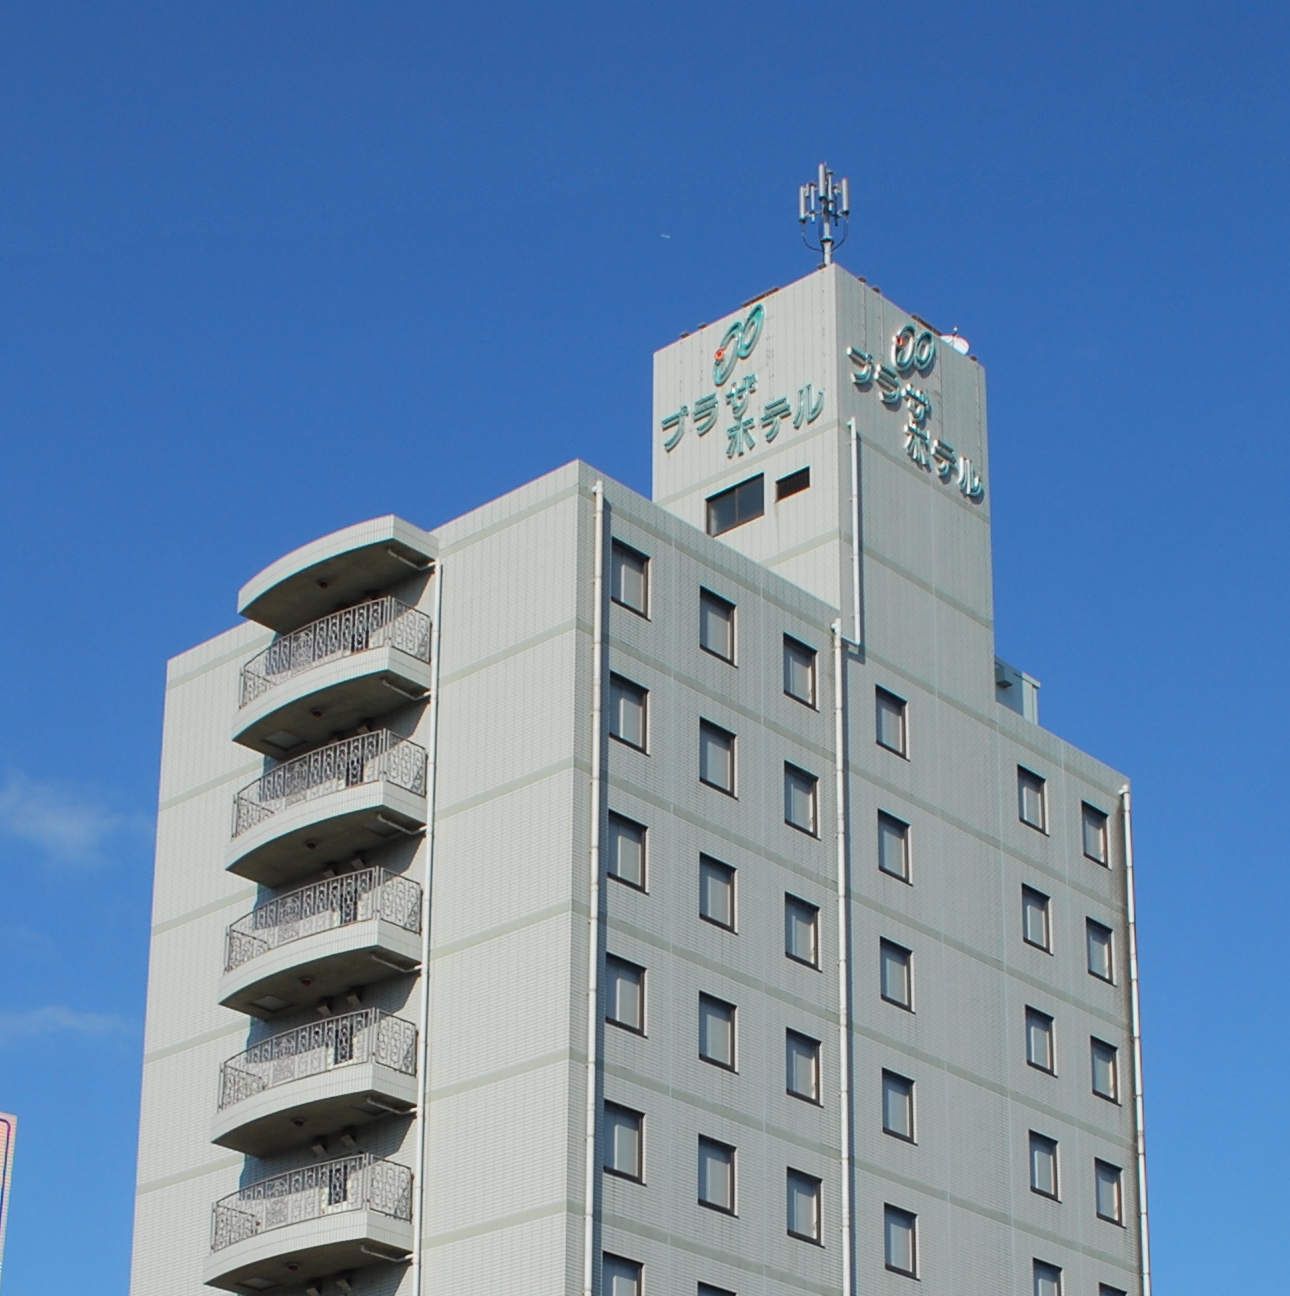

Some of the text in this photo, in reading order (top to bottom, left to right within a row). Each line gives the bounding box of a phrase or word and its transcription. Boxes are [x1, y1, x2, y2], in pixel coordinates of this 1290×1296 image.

[661, 373, 758, 452] プラザ
[726, 384, 824, 458] ホテル
[847, 345, 931, 423] プラザ
[903, 423, 984, 497] ホテル
